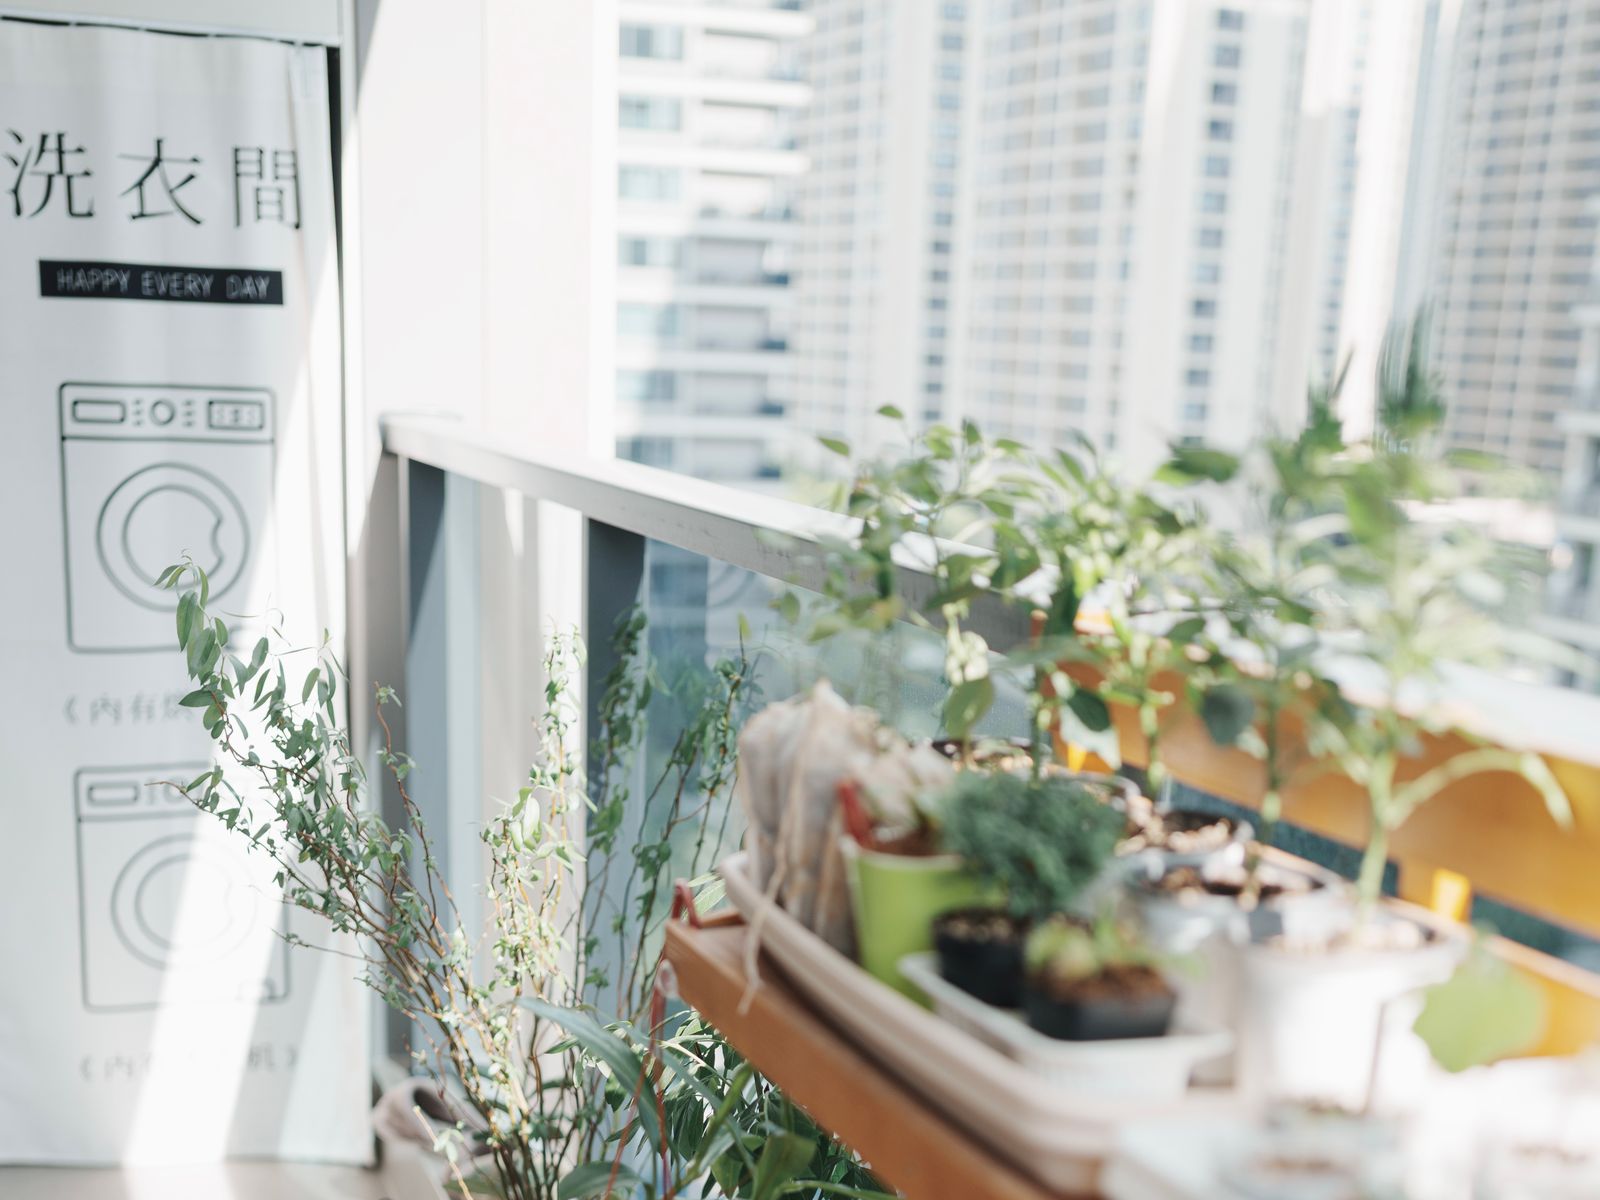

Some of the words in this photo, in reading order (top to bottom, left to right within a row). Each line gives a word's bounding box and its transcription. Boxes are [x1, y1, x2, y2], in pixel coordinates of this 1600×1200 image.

[3, 128, 302, 230] 洗衣間
[56, 267, 132, 294] HAPPY
[140, 270, 215, 297] EVERY
[225, 273, 271, 299] DAY
